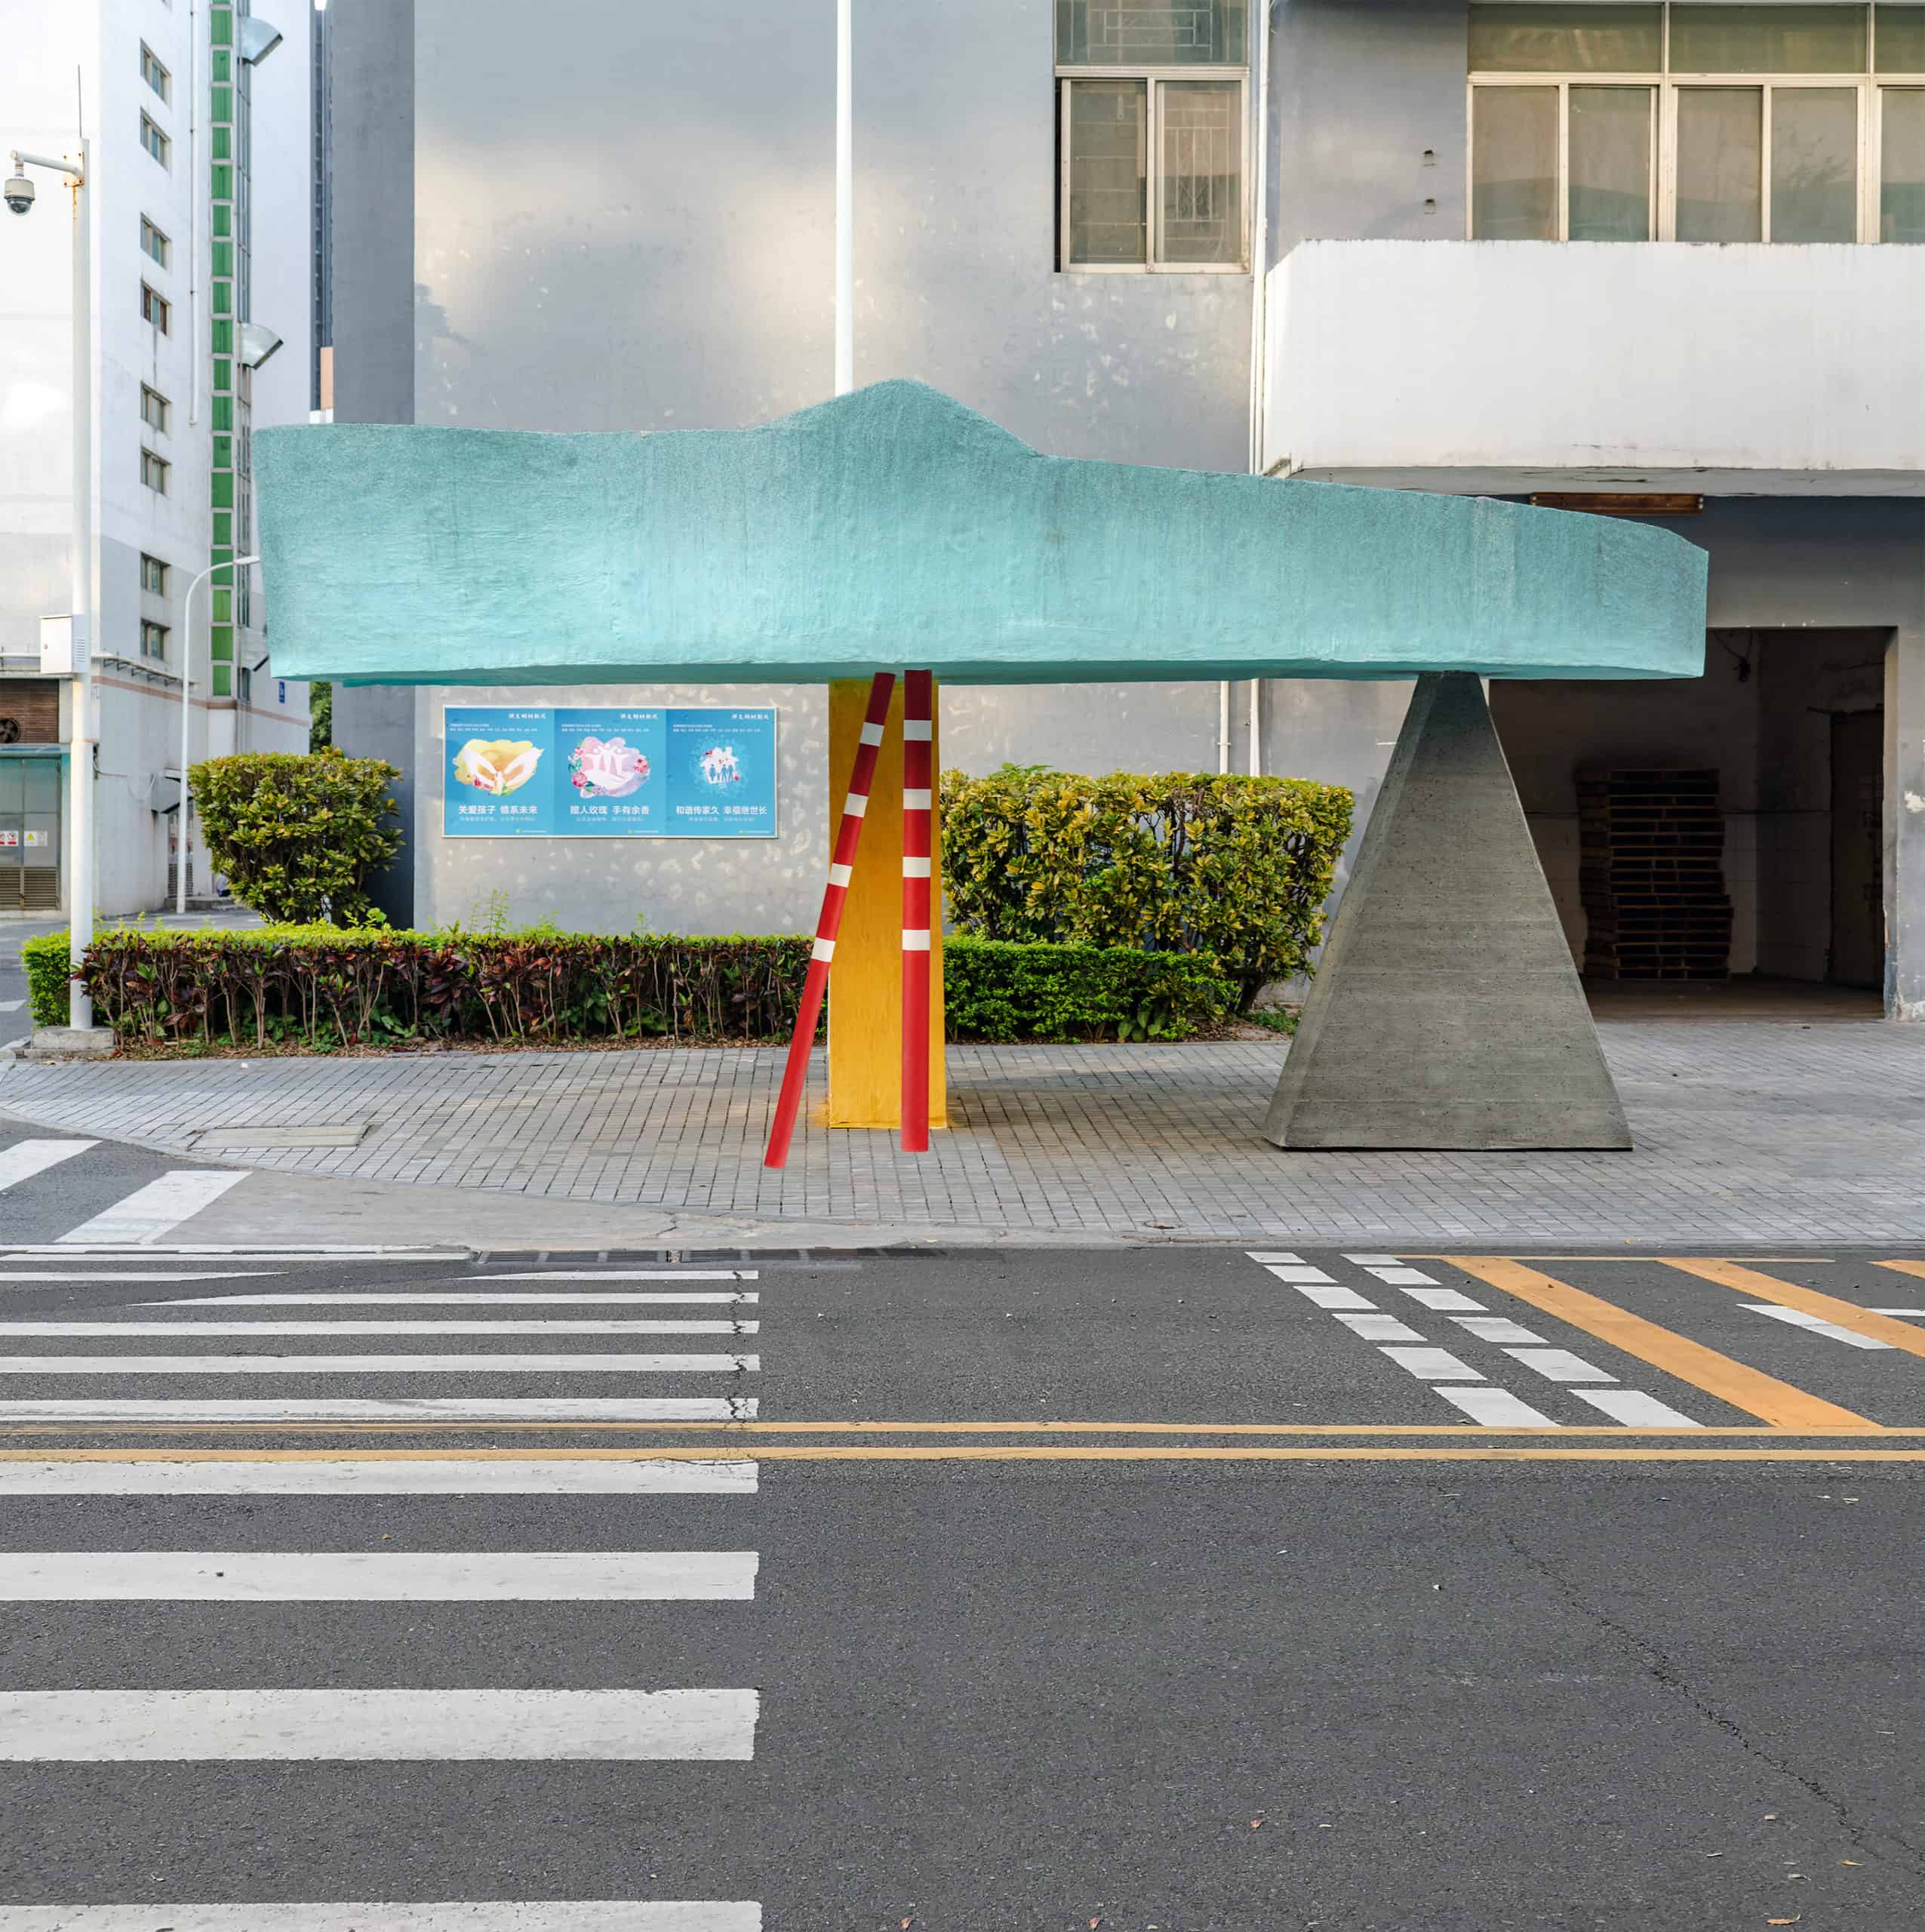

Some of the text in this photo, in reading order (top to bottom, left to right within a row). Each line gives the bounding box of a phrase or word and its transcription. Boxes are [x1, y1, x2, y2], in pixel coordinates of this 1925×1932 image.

[458, 804, 496, 815] 关爱孩子
[570, 804, 650, 815] 赠人玫瑰 手有余香
[676, 805, 719, 815] 和谐传家久
